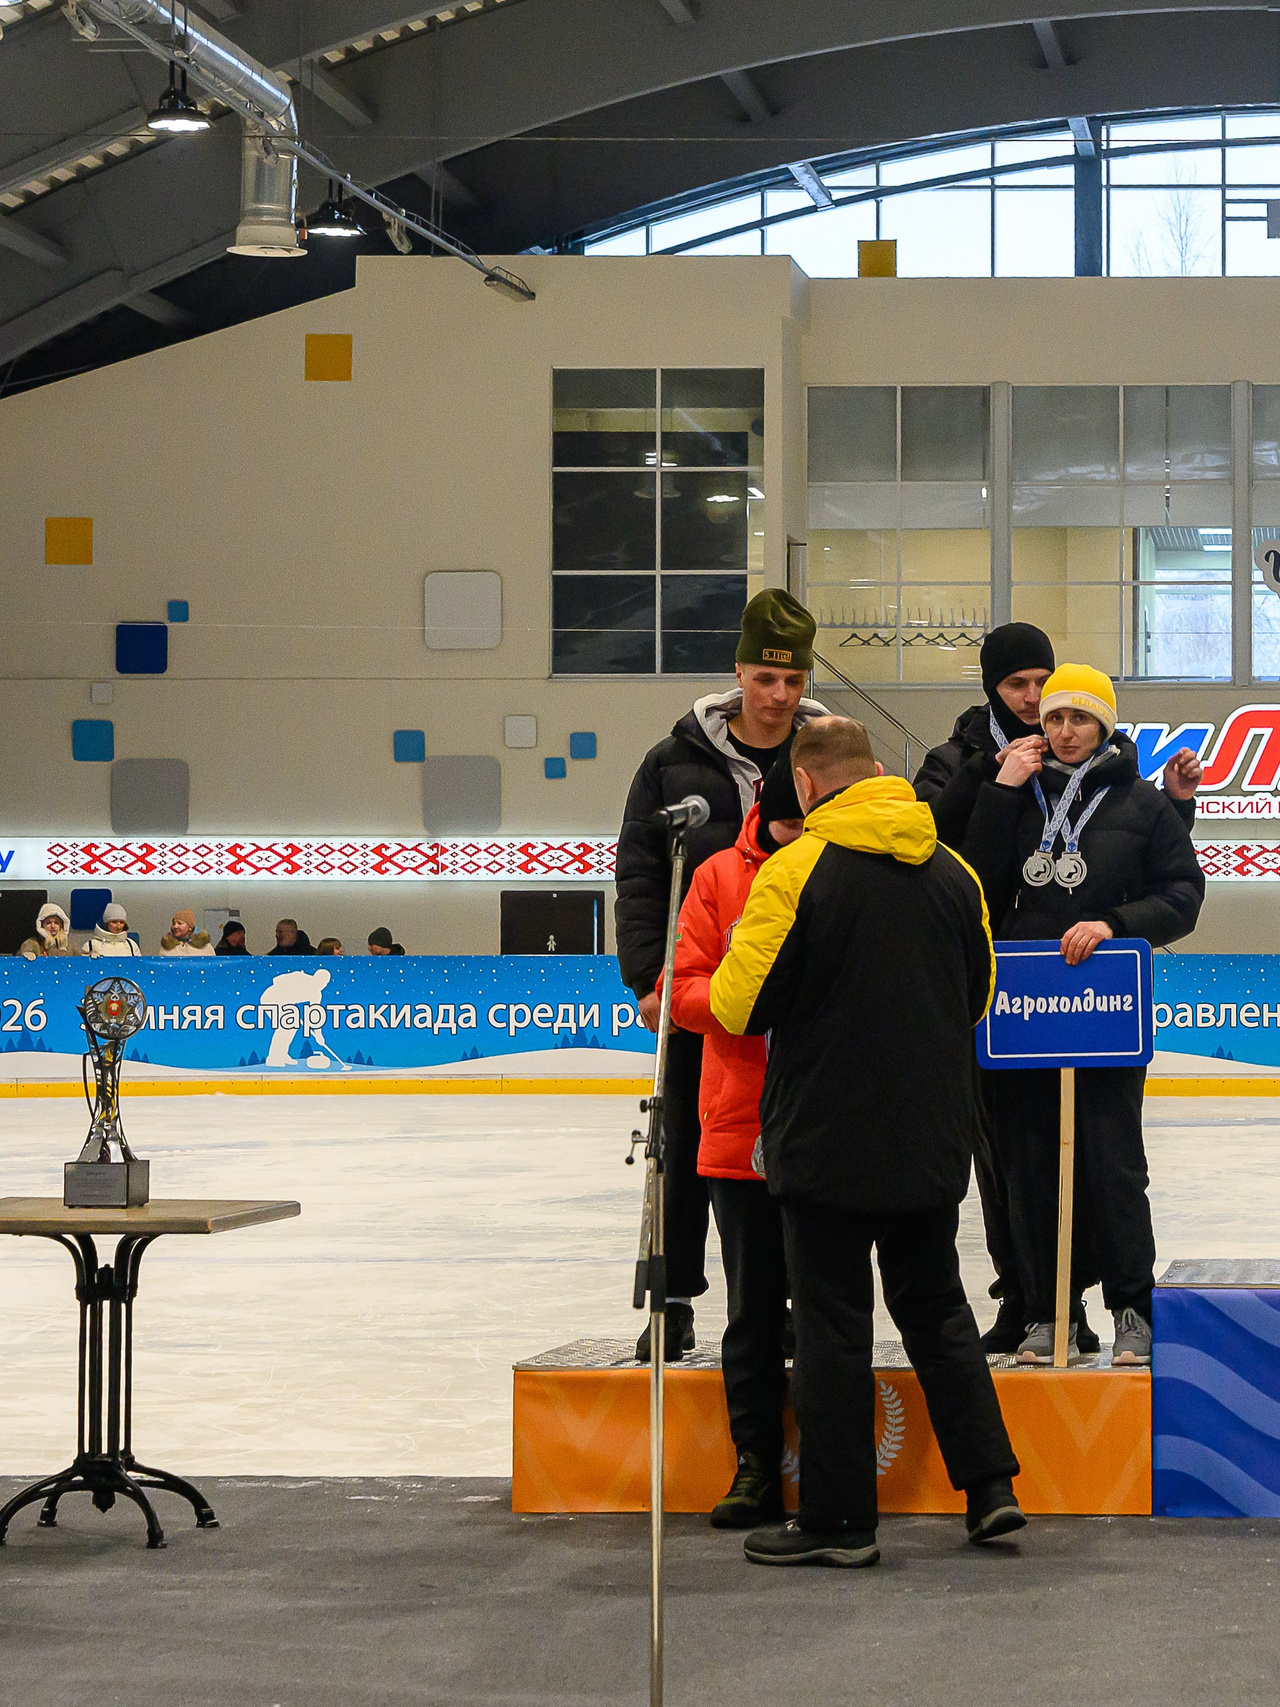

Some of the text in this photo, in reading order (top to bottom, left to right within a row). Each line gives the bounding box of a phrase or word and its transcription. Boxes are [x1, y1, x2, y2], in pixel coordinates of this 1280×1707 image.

[235, 1003, 477, 1038] спартакиада
[487, 1002, 600, 1037] среди
[994, 987, 1134, 1021] Агрохолдинг
